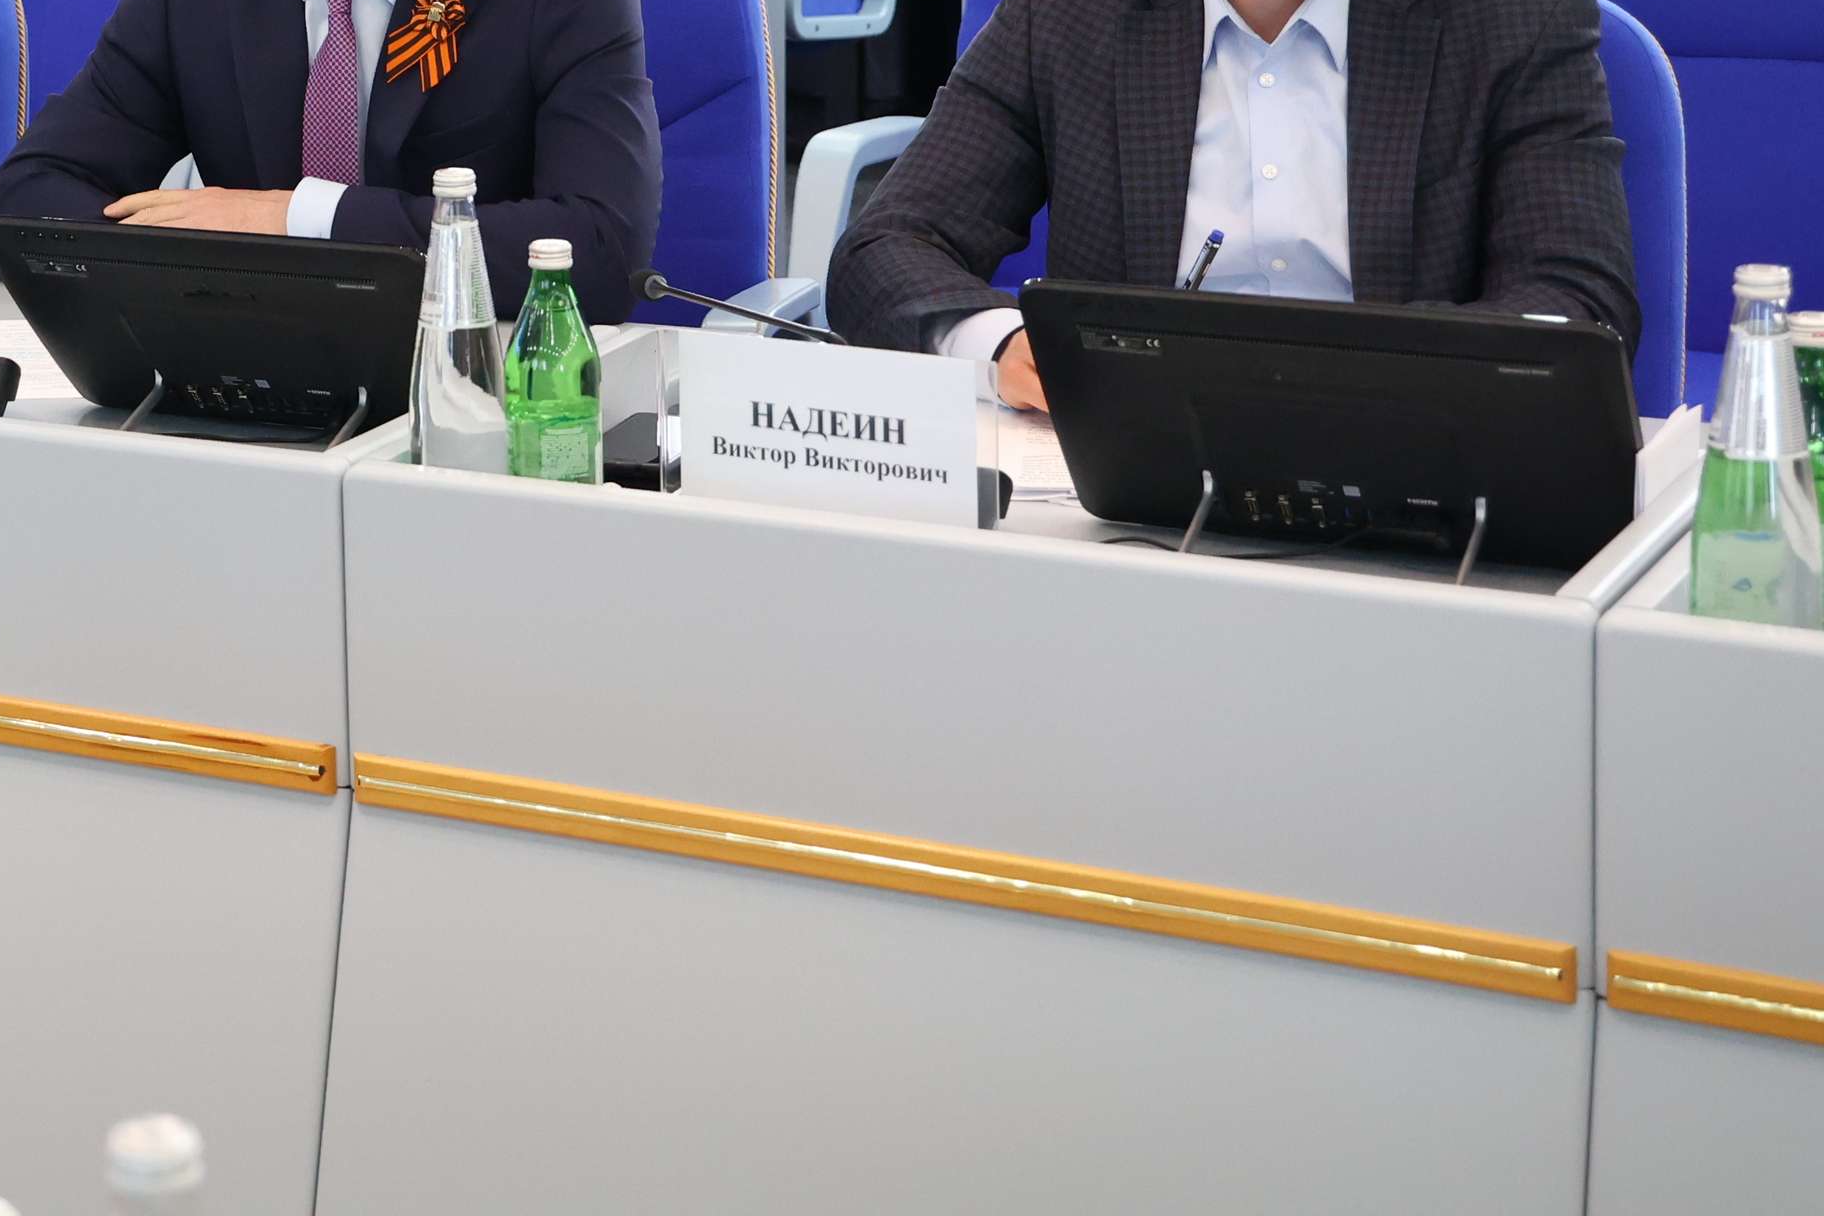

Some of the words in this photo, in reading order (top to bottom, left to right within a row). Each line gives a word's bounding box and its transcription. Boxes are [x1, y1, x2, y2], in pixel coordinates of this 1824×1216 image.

[752, 401, 905, 445] НАДЕИН
[713, 436, 796, 470] Виктор
[805, 447, 947, 484] Викторович
